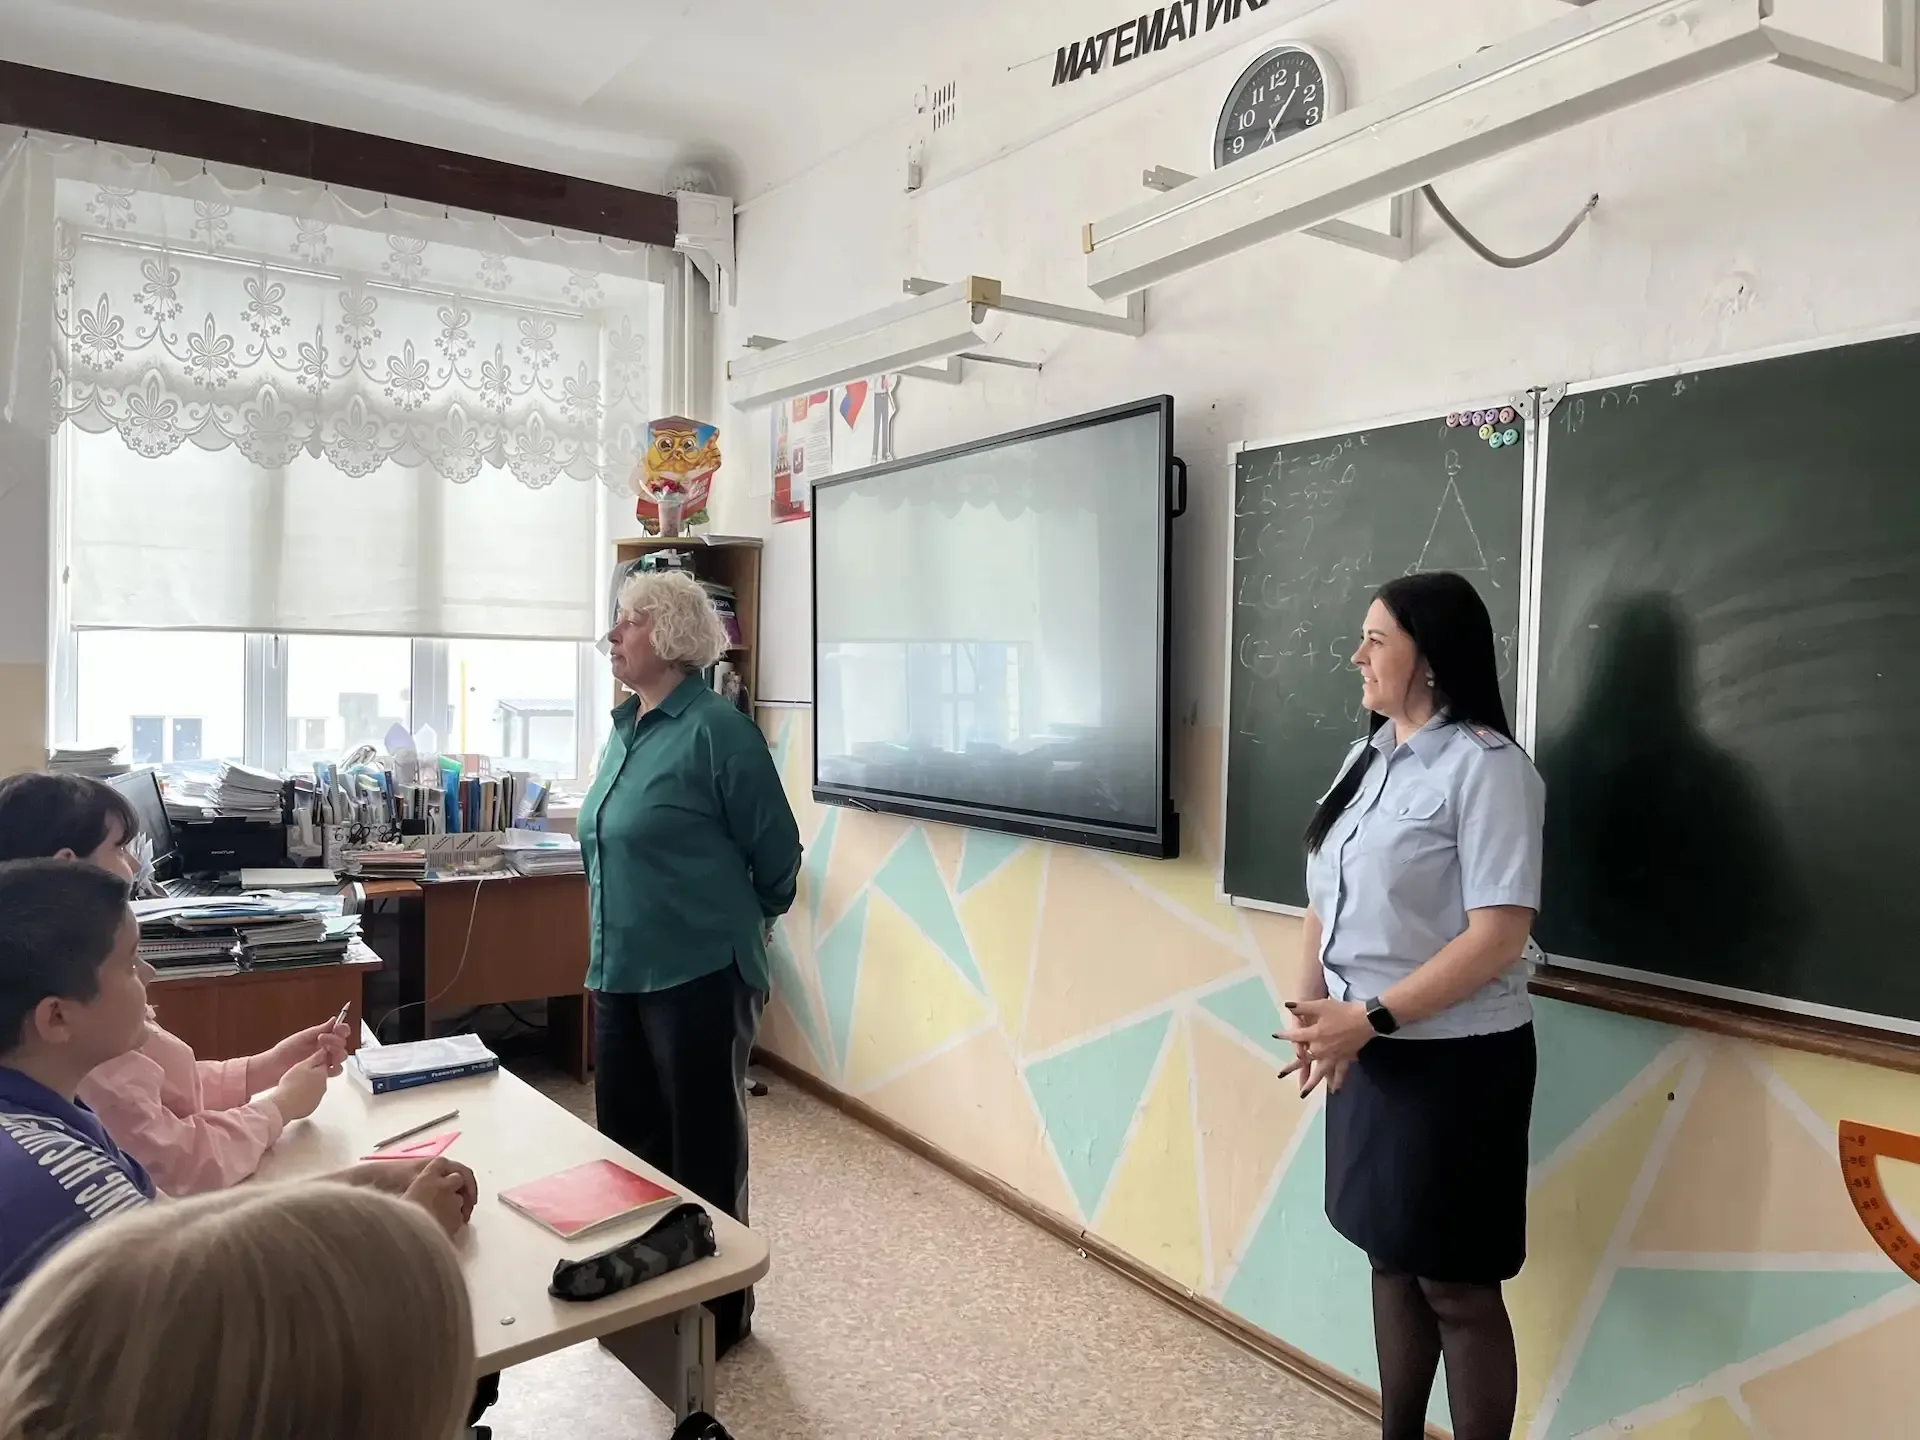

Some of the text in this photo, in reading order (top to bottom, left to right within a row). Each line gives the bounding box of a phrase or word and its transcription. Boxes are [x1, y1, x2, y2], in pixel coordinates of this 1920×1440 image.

[1051, 0, 1270, 87] МАТЕМАТИК
[1269, 68, 1287, 91] 12
[1293, 70, 1301, 89] 1
[1251, 85, 1264, 106] 11
[1303, 84, 1317, 104] 2
[1238, 109, 1256, 131] 10
[1305, 106, 1319, 126] 3
[1232, 135, 1245, 155] 9
